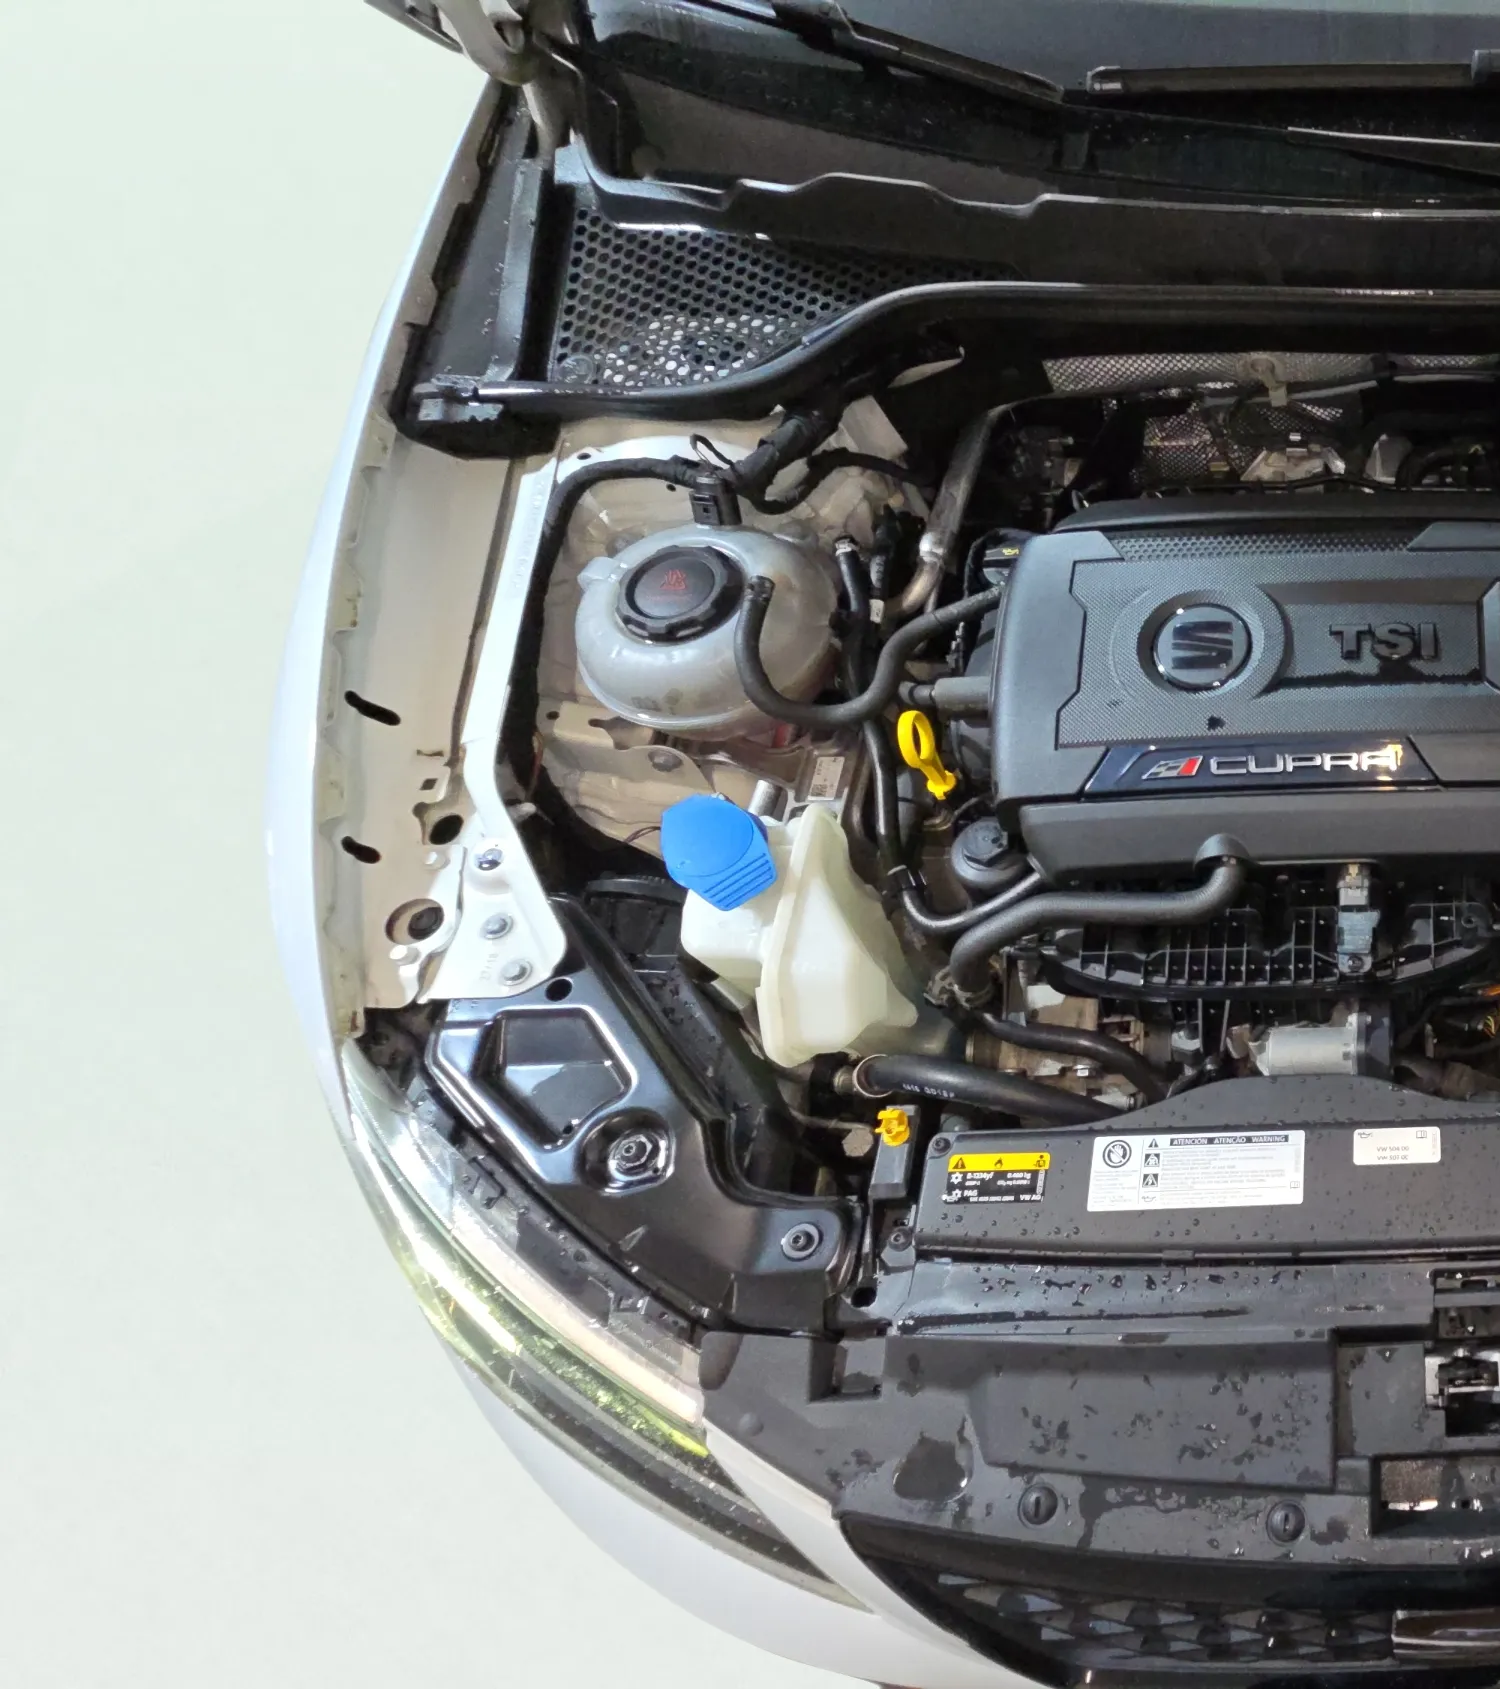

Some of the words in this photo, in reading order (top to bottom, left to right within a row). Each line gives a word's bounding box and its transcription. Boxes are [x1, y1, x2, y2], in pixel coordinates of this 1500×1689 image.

[1329, 621, 1442, 662] TSI
[1209, 746, 1404, 775] CUPRA
[1172, 1137, 1208, 1146] ATENCIÓN
[1213, 1135, 1247, 1145] ATENÇÃO
[1251, 1135, 1286, 1143] WARNING
